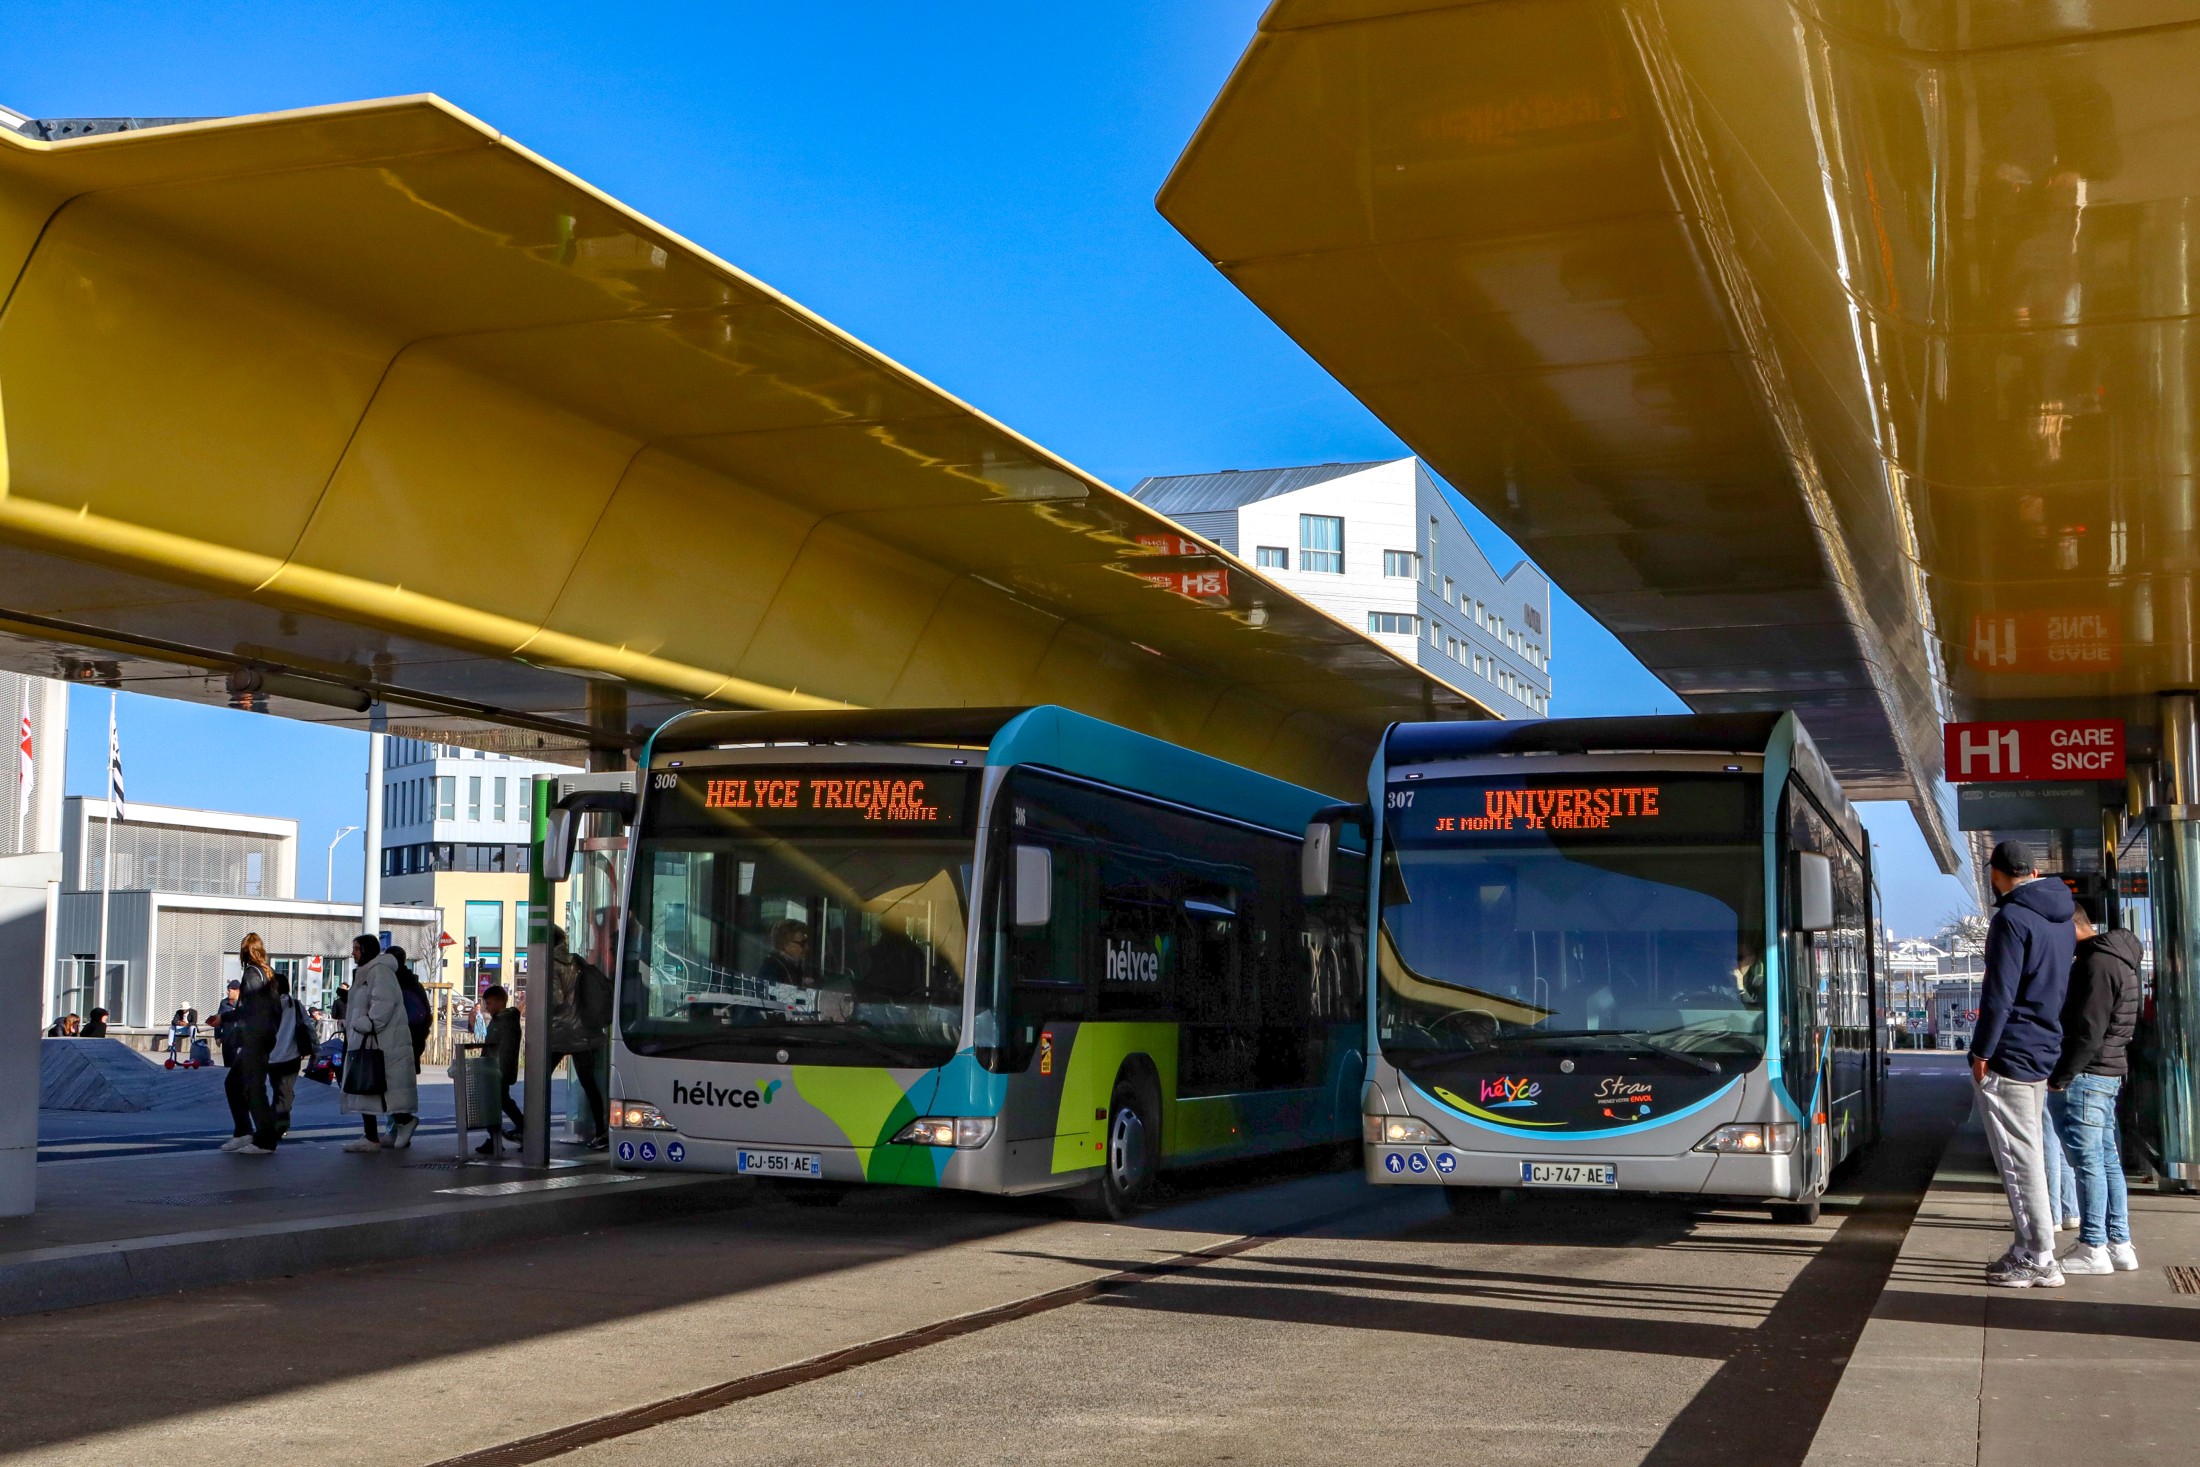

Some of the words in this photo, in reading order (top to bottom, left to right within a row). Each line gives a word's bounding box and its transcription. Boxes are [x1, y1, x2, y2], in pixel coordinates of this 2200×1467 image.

[2050, 728, 2115, 748] GARE
[1959, 729, 2021, 775] H1
[2051, 751, 2115, 770] SNCF
[654, 773, 678, 789] 306
[704, 780, 800, 808] HELYCE
[810, 780, 924, 809] TRIGNAC
[1387, 791, 1415, 809] 307
[1485, 787, 1660, 818] UNIVERSITE
[863, 806, 882, 820] JE
[887, 806, 938, 820] MONTE
[1015, 808, 1026, 827] 306
[1435, 817, 1455, 832] JE
[1460, 814, 1514, 831] MONTE
[1525, 815, 1546, 830] JE
[1552, 813, 1611, 829] VALIDE
[1594, 1075, 1652, 1098] Stran
[1533, 1166, 1604, 1183] CJ-747-AE
